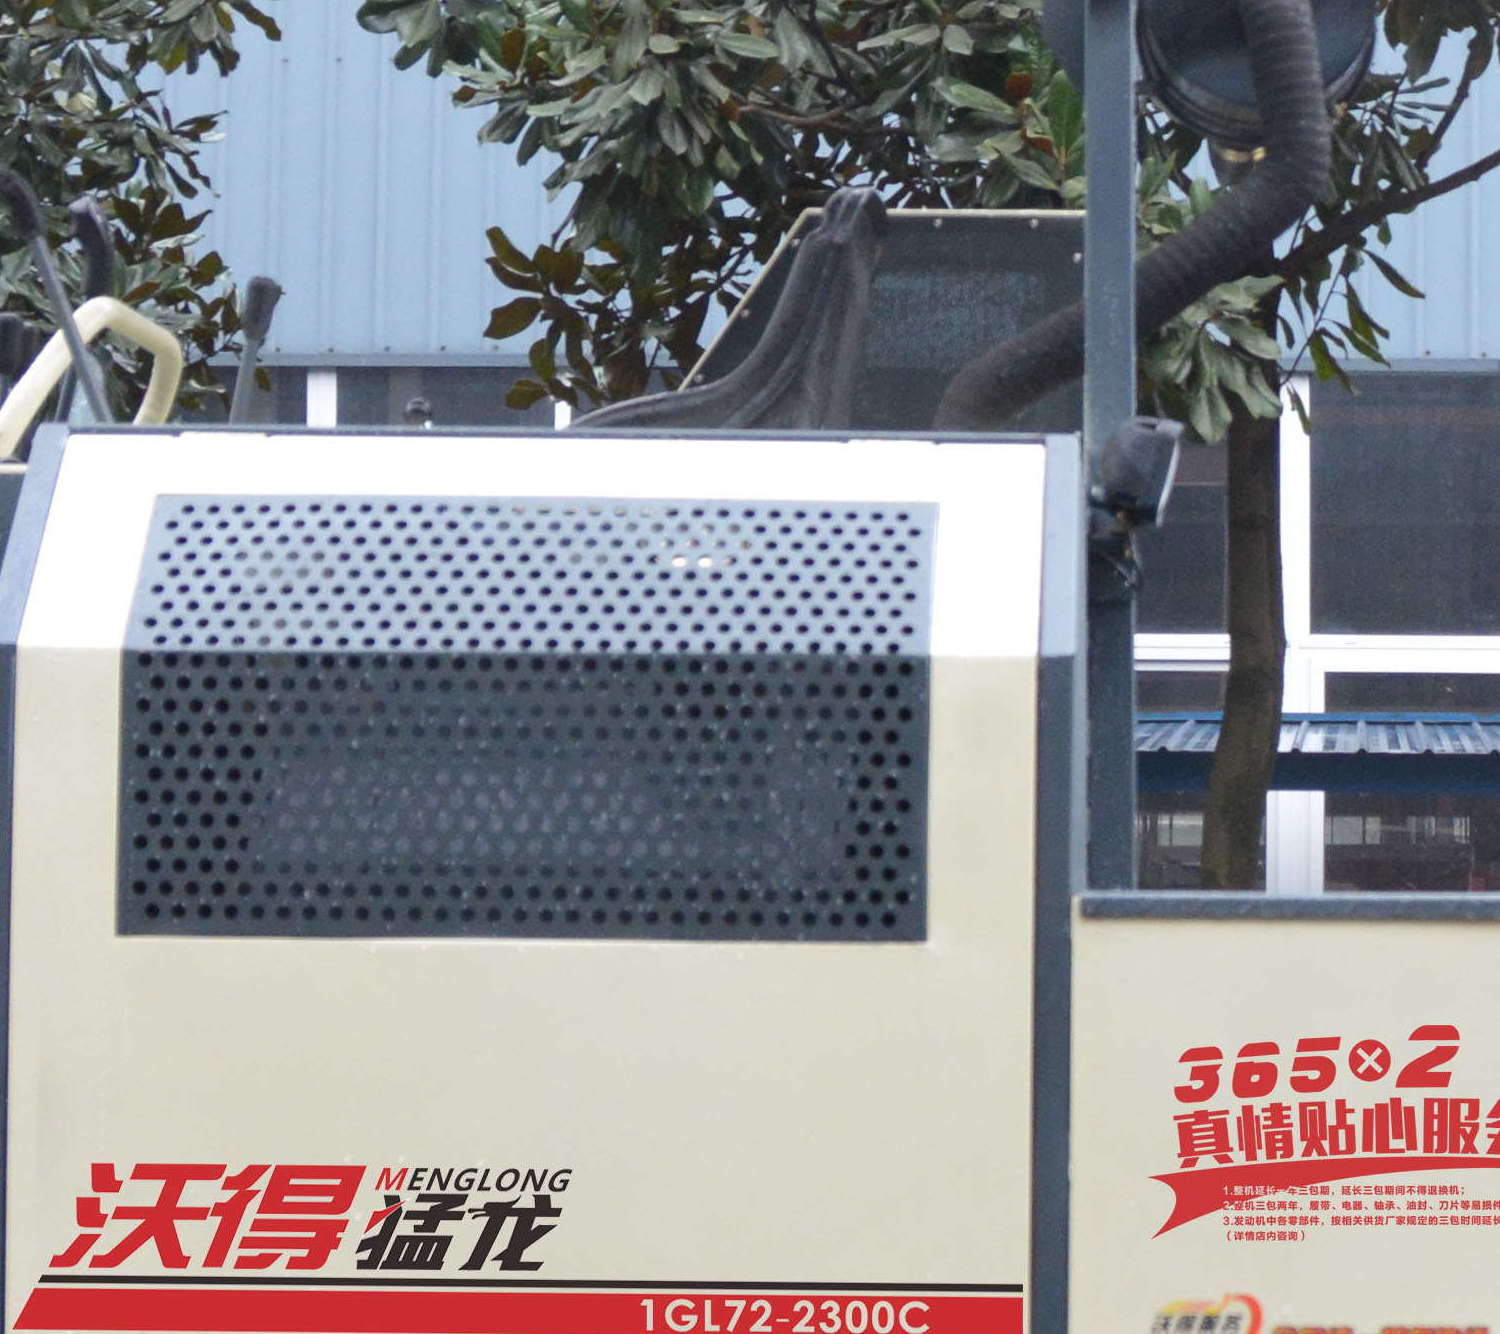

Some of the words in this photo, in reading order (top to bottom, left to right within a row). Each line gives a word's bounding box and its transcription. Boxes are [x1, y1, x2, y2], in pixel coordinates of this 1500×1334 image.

[375, 1167, 573, 1193] MENGLONG
[48, 1163, 367, 1270] 沃得
[356, 1194, 563, 1271] 猛龙
[640, 1298, 930, 1334] 1GL72-2300C
